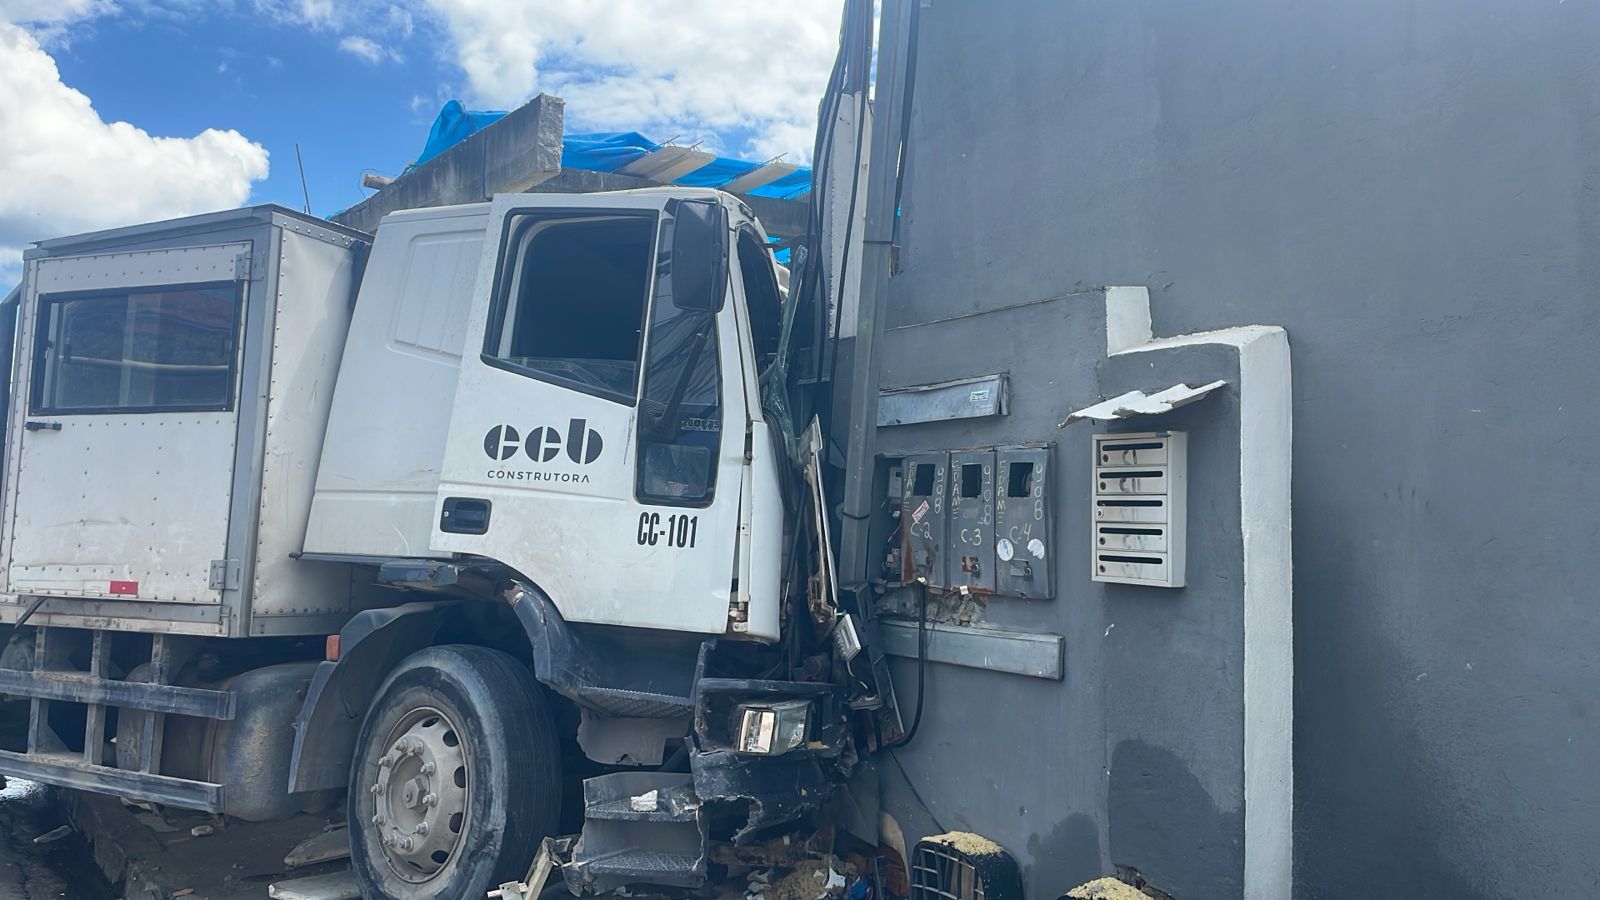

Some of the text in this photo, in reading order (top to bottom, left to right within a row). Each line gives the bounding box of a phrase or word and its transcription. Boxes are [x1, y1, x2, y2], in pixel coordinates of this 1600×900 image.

[487, 470, 590, 484] CONSTRUTORA
[1033, 463, 1043, 520] 908
[637, 511, 698, 548] CC-101
